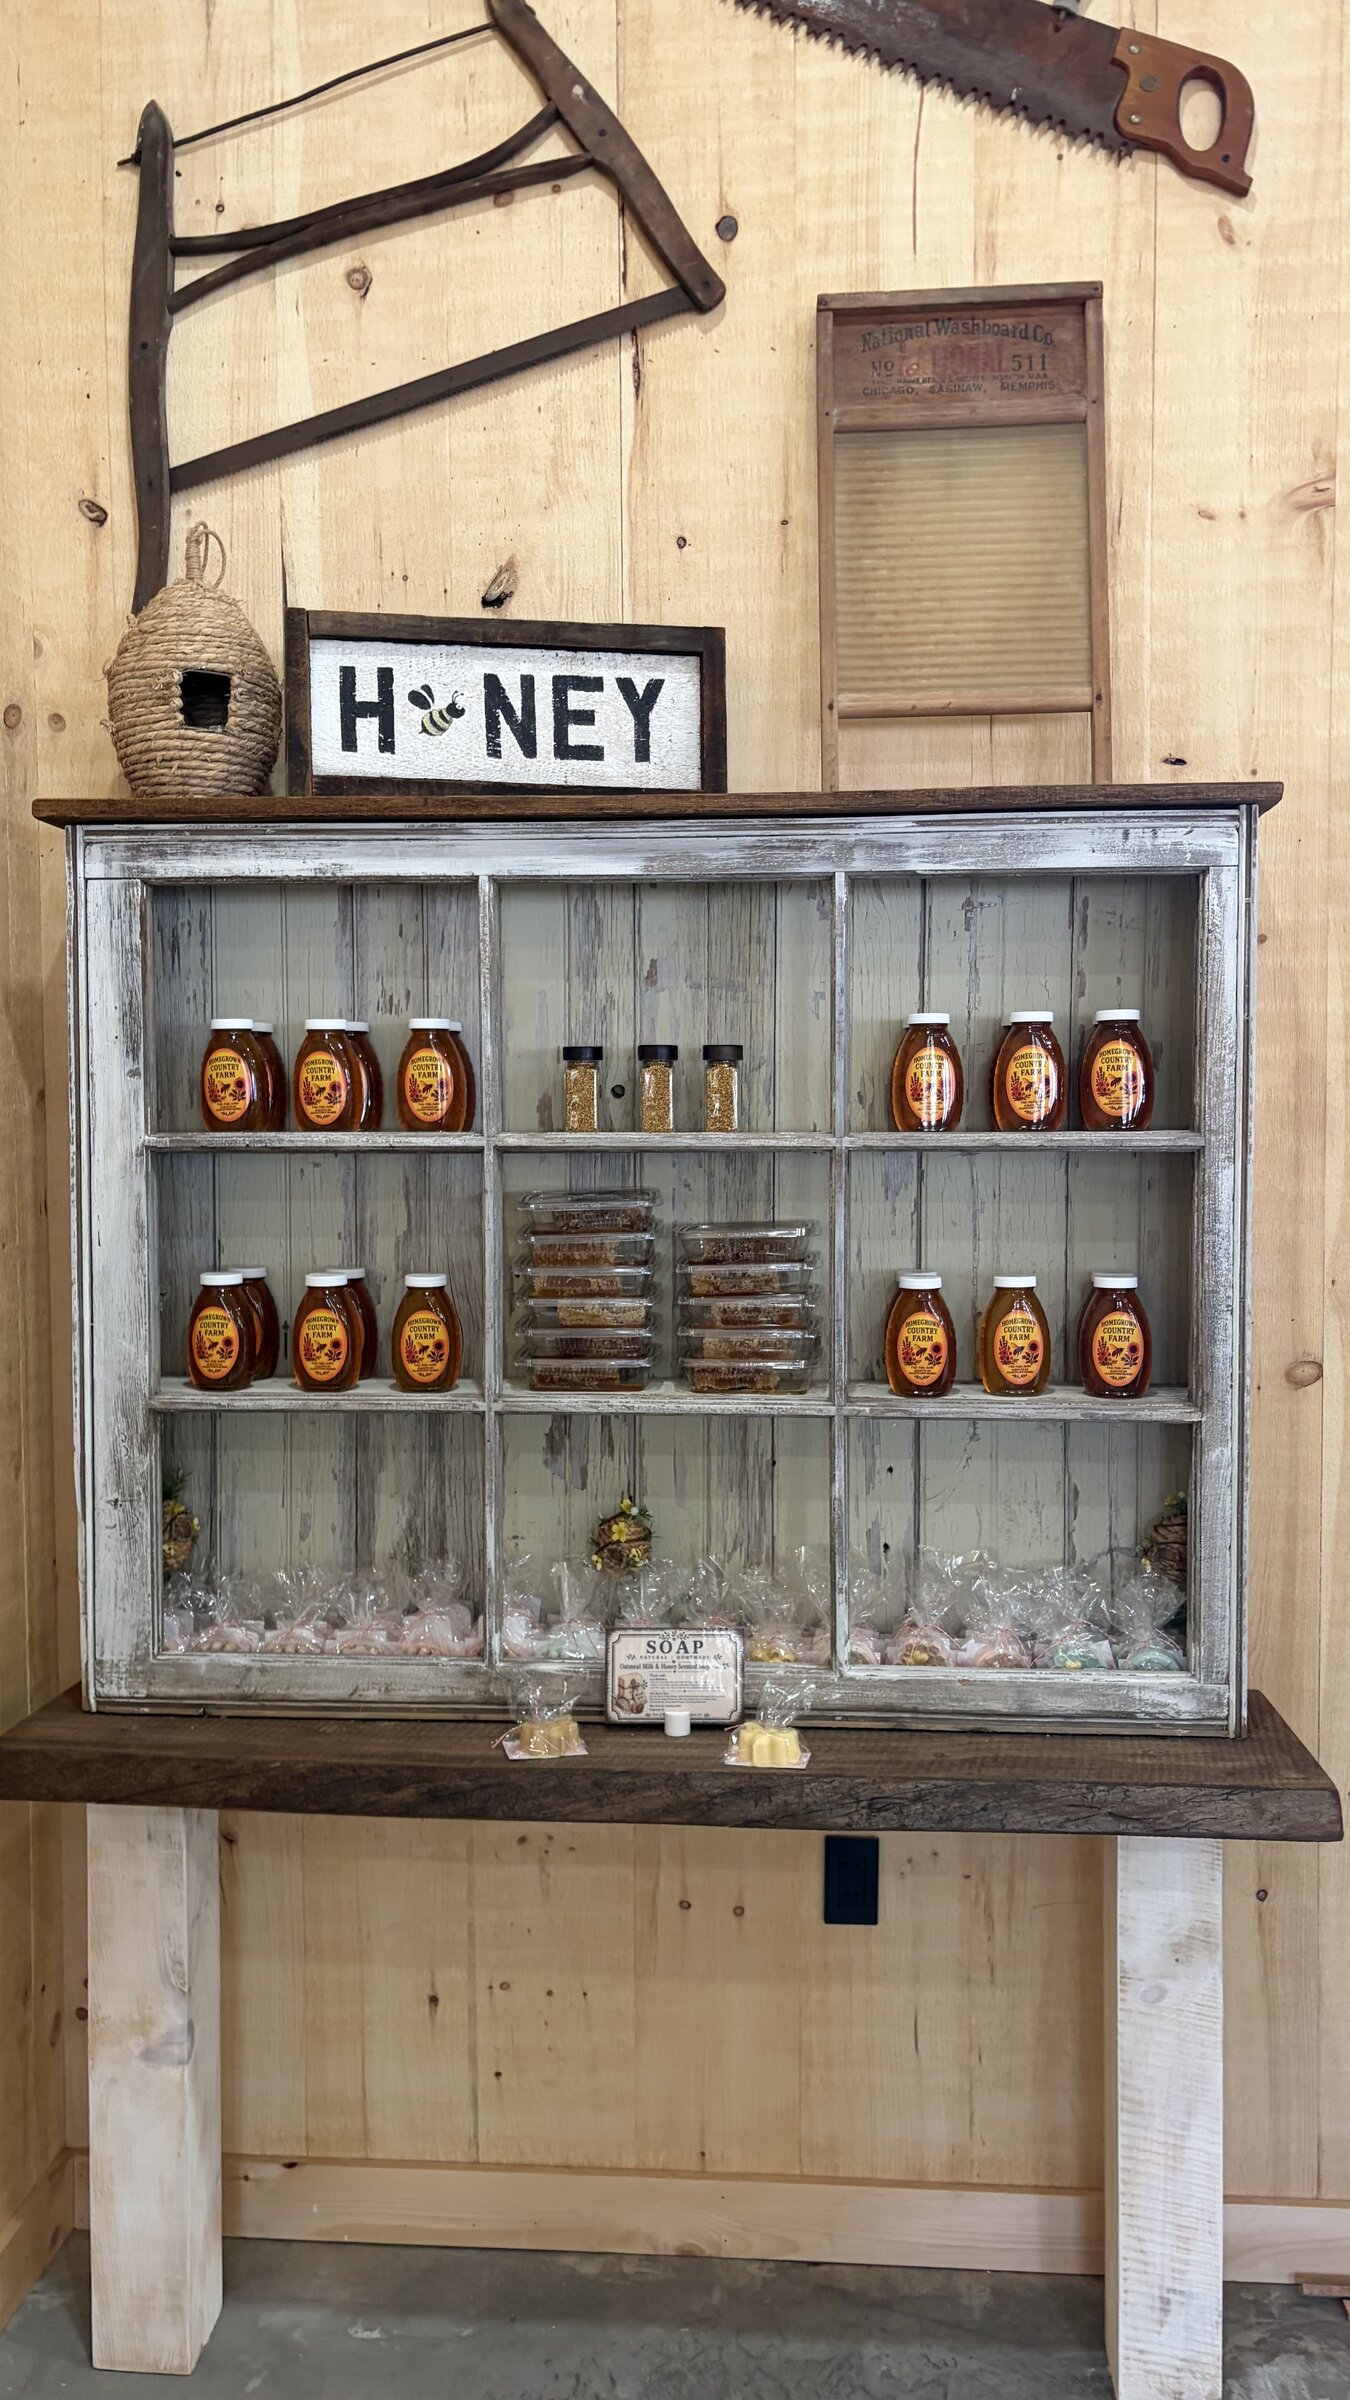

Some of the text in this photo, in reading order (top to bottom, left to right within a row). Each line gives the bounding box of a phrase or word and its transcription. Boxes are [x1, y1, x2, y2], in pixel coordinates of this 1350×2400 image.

[861, 317, 1056, 352] National Washboard Co.
[1011, 354, 1047, 371] 511
[862, 386, 918, 396] CHICAGO,
[1000, 381, 1056, 391] MEMPHIS
[339, 665, 665, 763] HNEY
[304, 1059, 336, 1068] HOMEGROW
[1101, 1056, 1133, 1064] COUNTRY
[210, 1063, 239, 1071] COUNTRY
[200, 1321, 228, 1329] COUNTRY
[409, 1325, 440, 1333] COUNTRY
[907, 1327, 938, 1335] COUNTRY
[1102, 1327, 1135, 1335] COUNTRY
[646, 1640, 704, 1654] SOAP
[661, 1663, 677, 1671] Honey
